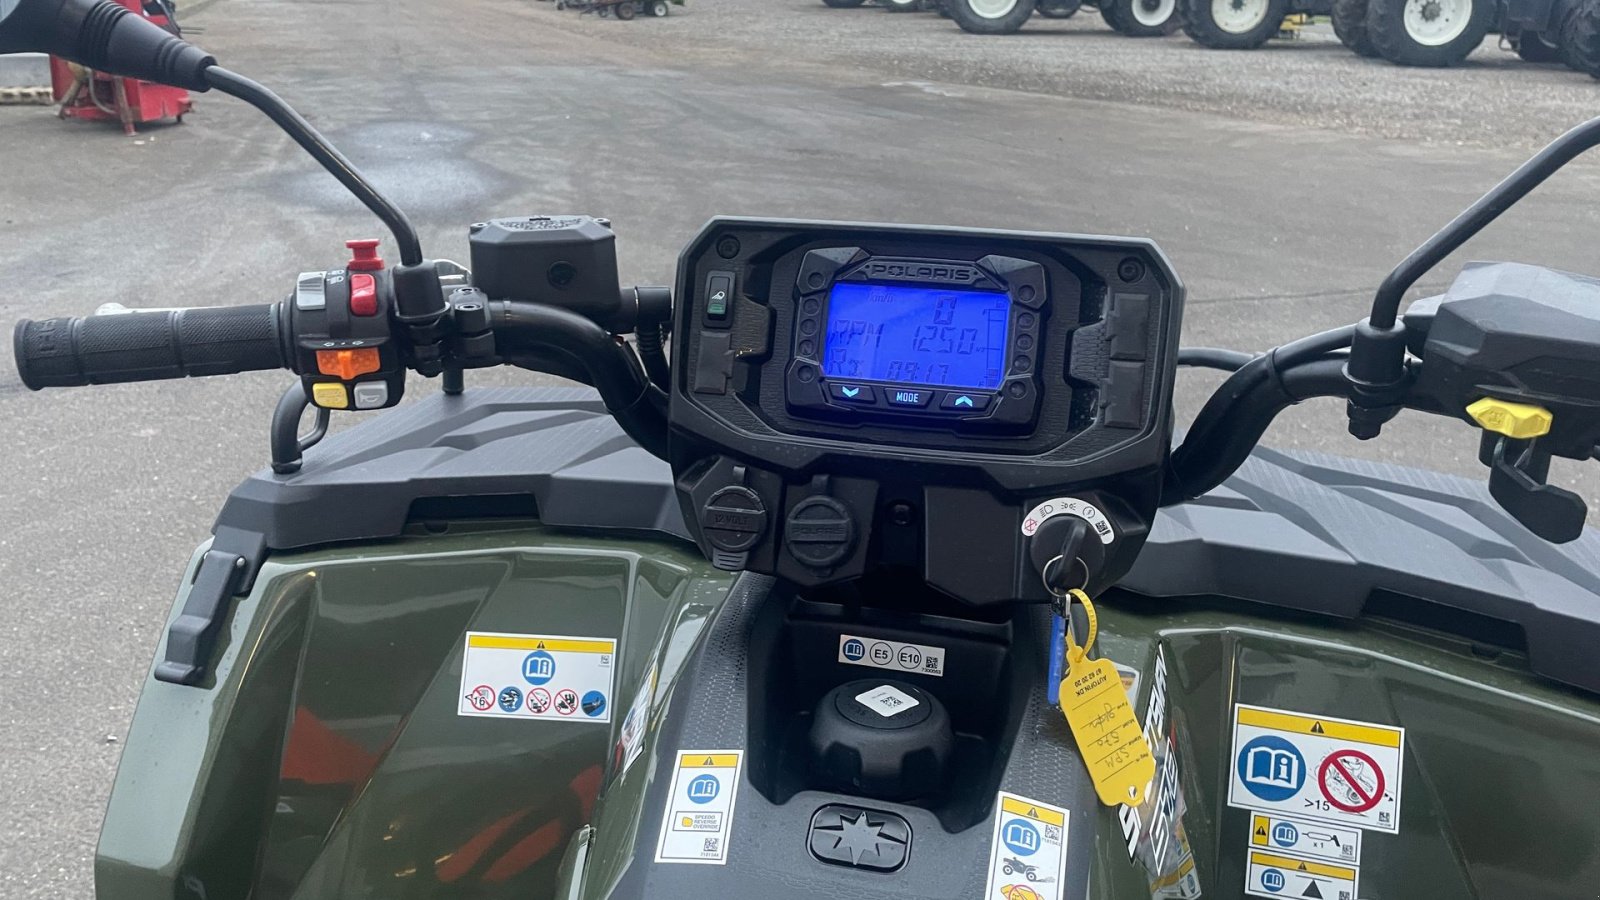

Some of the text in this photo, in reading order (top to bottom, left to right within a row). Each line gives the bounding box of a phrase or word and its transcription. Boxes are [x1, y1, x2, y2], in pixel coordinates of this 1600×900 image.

[872, 264, 970, 281] POLARIS
[934, 297, 957, 325] 0
[913, 326, 978, 355] 1250
[896, 392, 919, 403] MODE
[874, 649, 920, 664] E5 E10
[1304, 798, 1330, 811] >15
